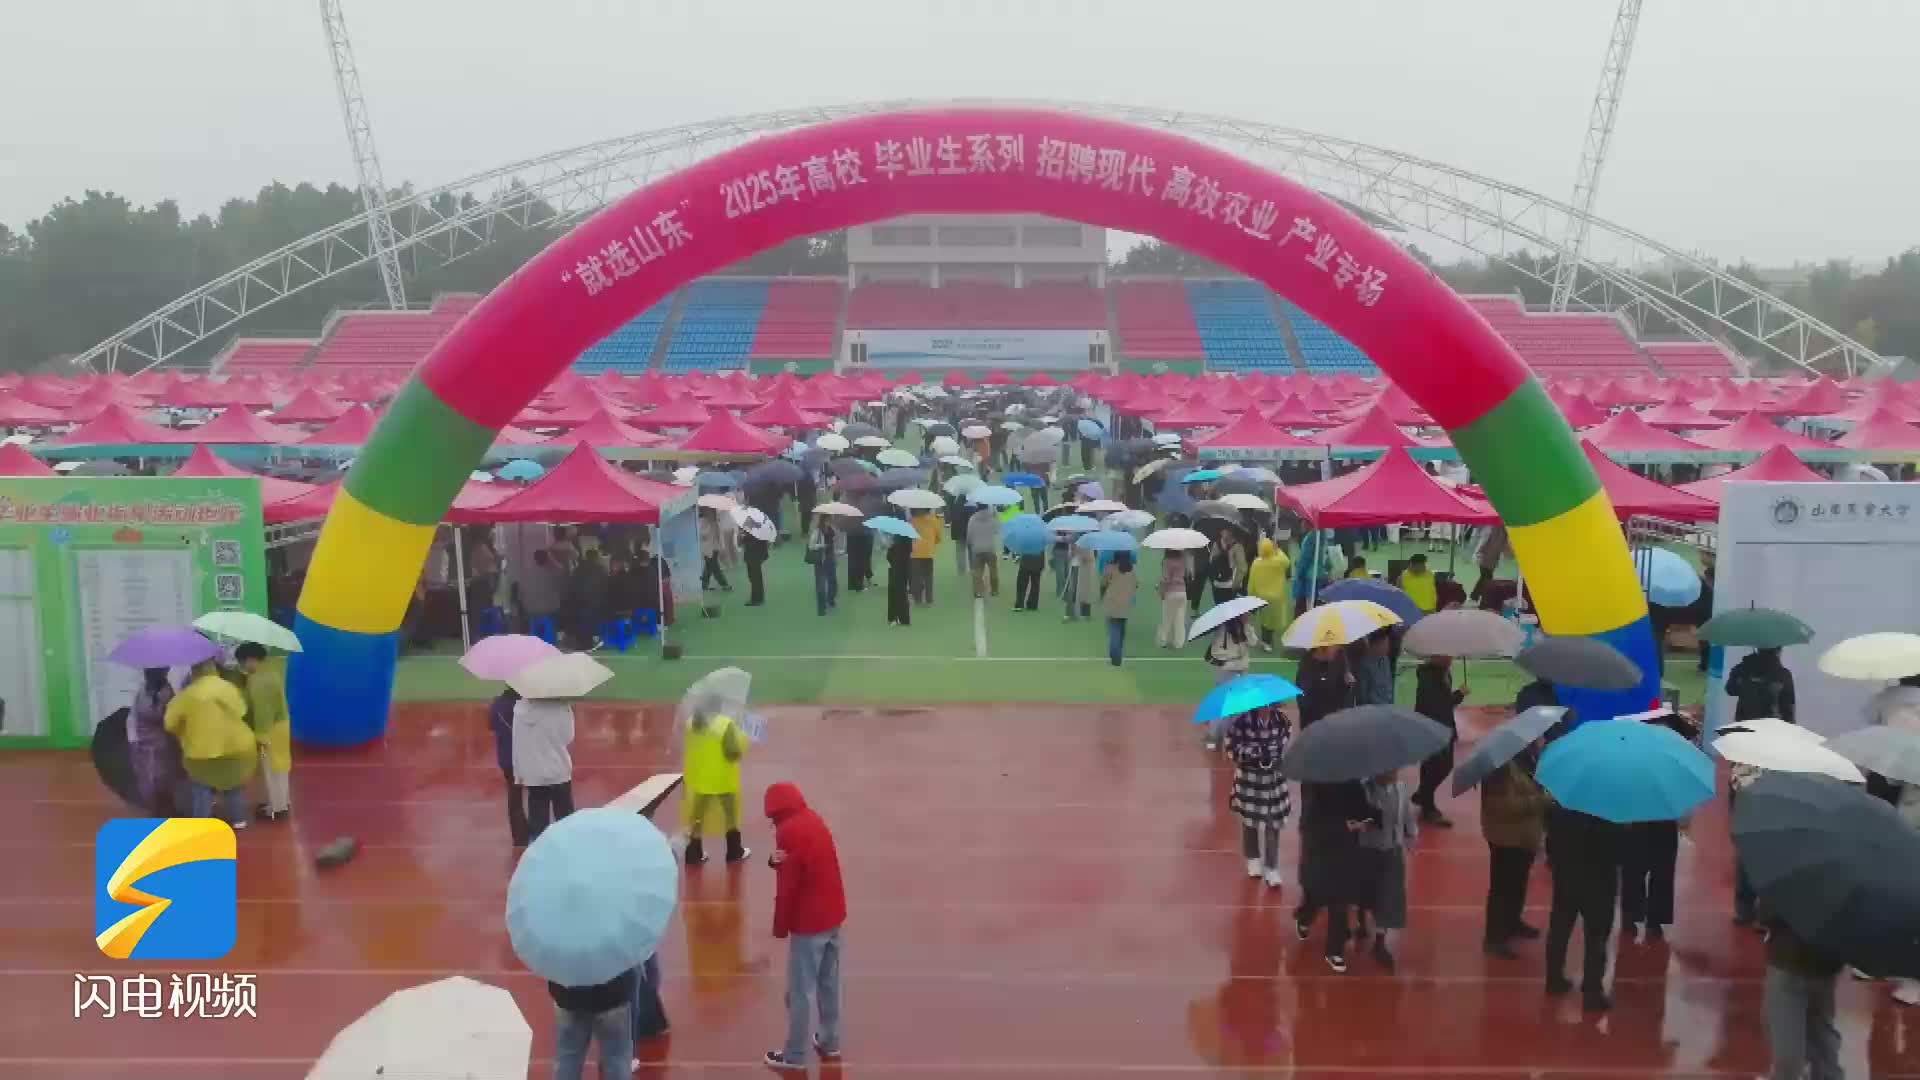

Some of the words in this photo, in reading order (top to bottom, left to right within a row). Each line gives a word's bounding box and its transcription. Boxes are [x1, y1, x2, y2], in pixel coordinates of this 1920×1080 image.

[719, 147, 867, 219] 2025年高校
[874, 133, 1025, 181] 毕业生系列
[1036, 136, 1158, 197] 招聘现代
[1161, 165, 1280, 241] 高效农业
[1278, 216, 1389, 307] 产业专场
